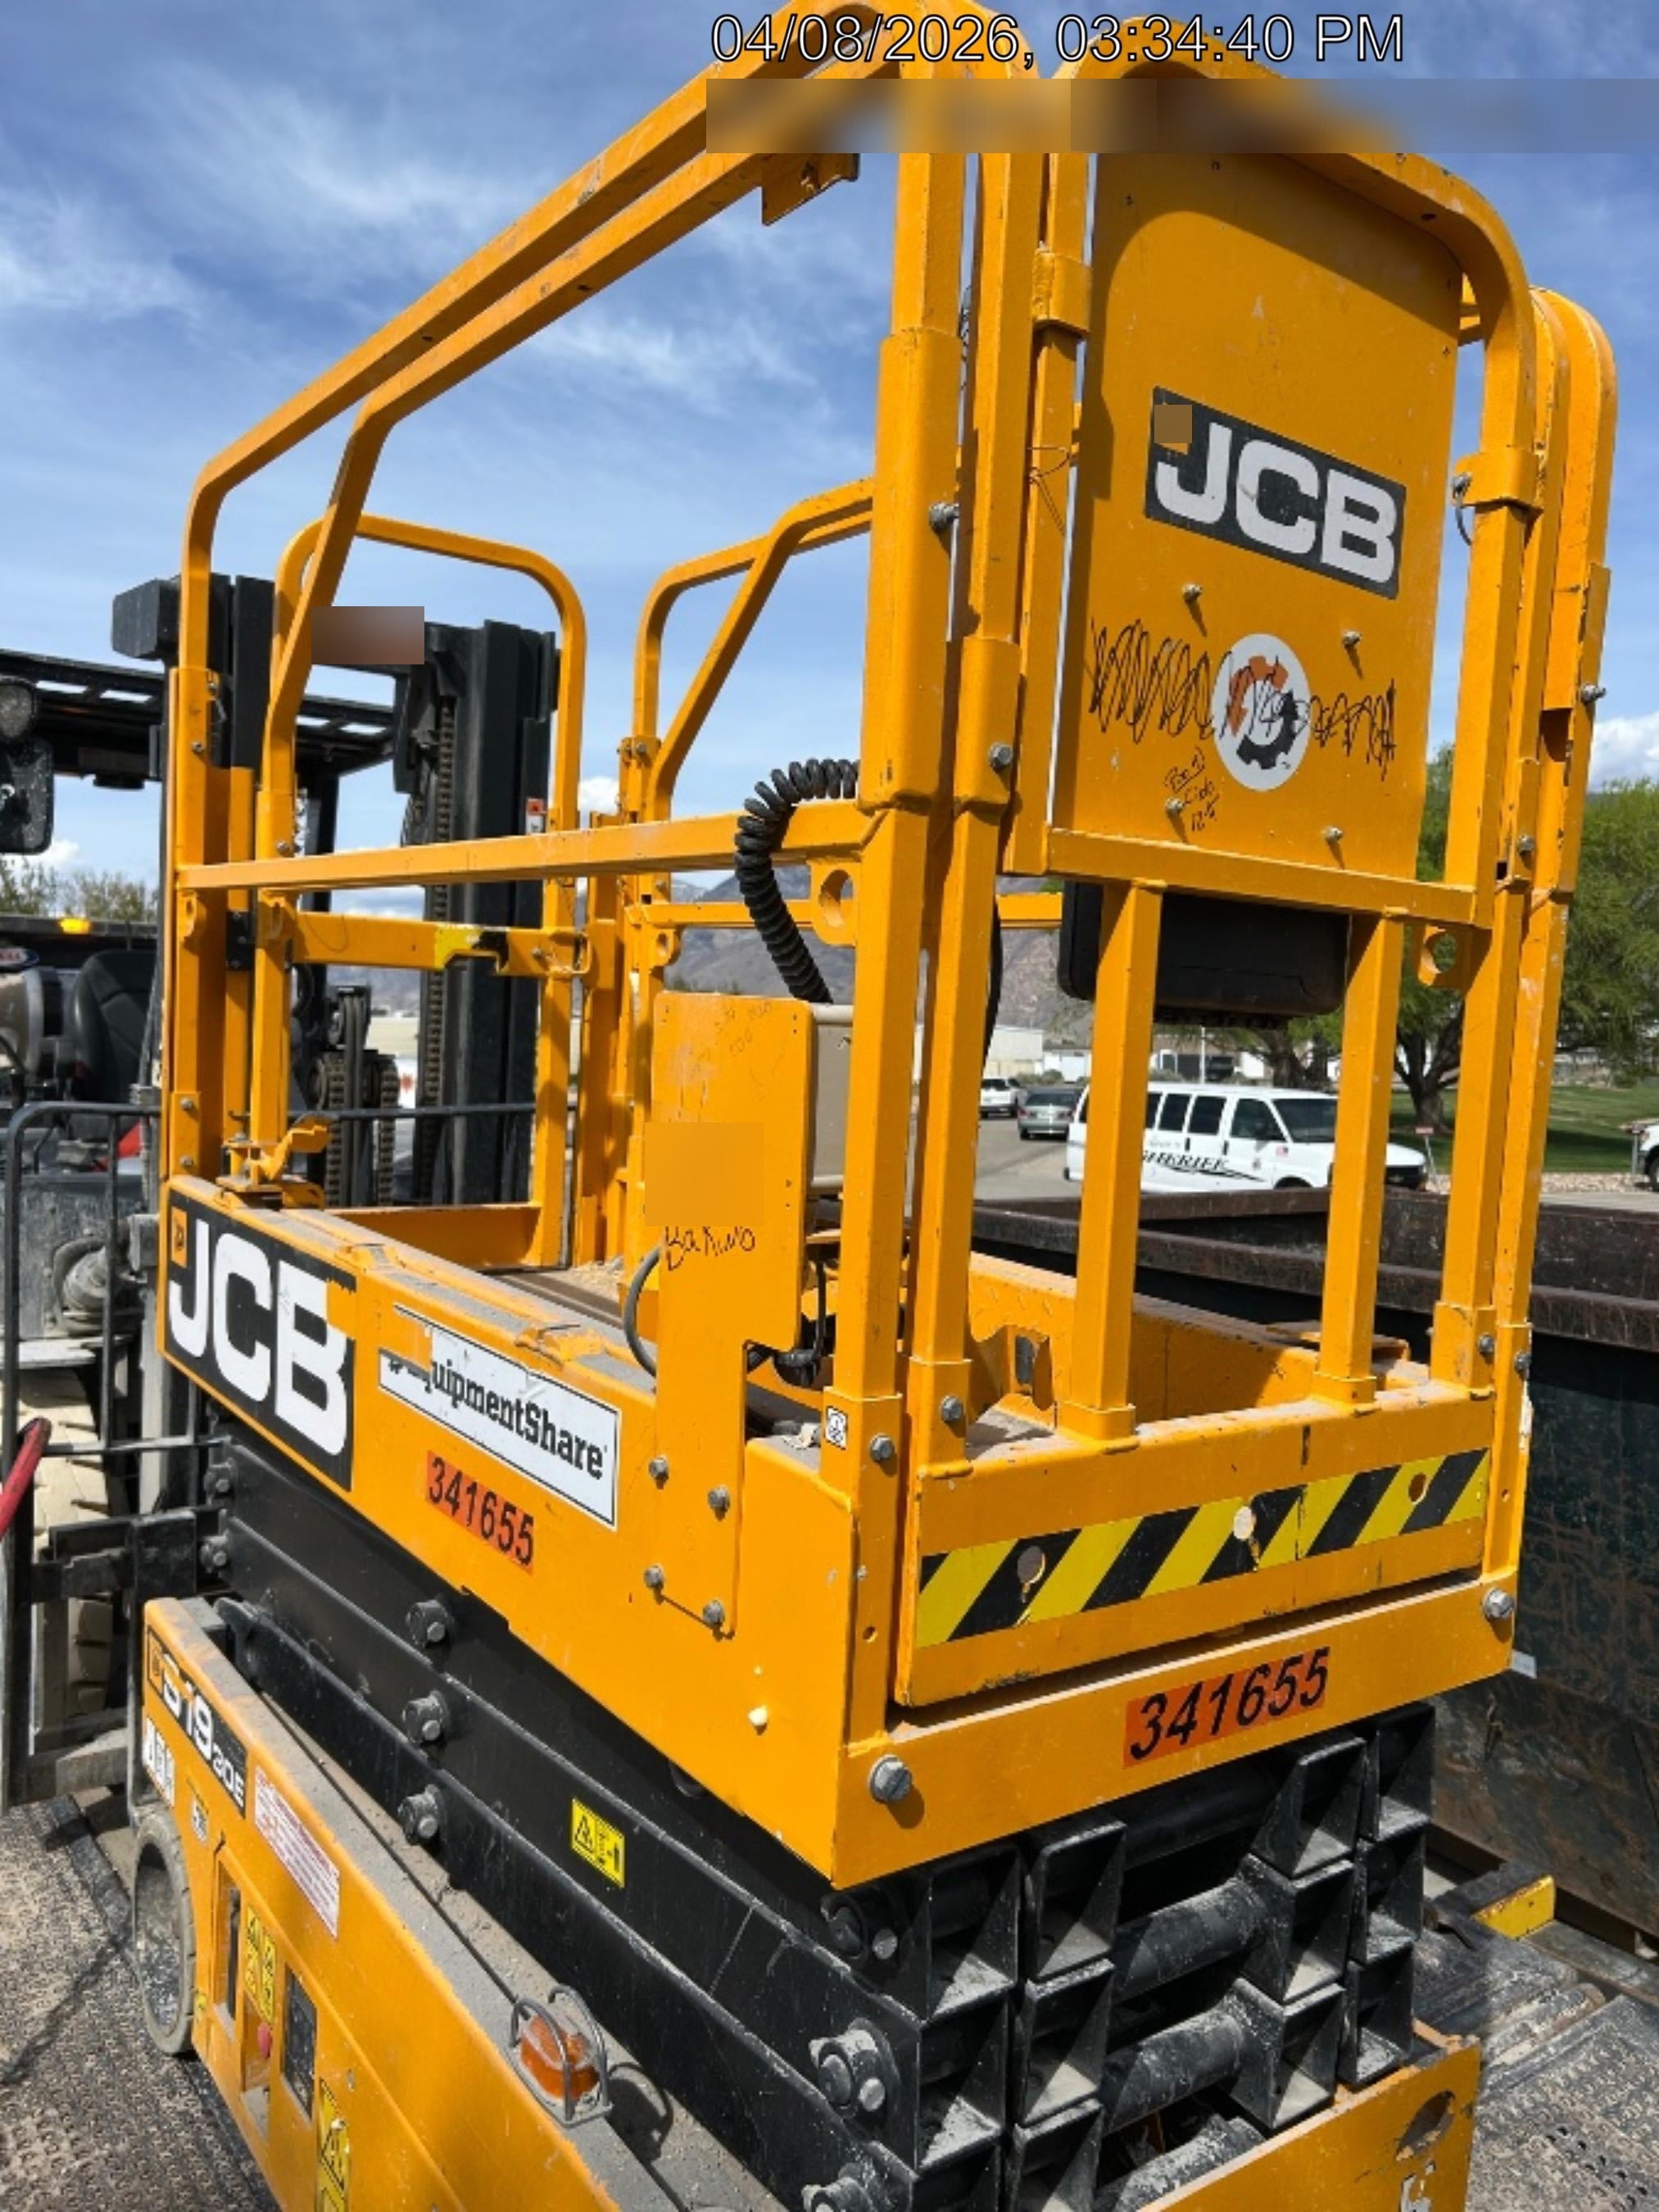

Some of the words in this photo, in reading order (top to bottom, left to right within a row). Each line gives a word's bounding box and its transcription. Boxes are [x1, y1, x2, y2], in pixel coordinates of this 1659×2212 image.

[1154, 421, 1398, 585] JCB
[168, 1218, 347, 1457] JCB
[408, 1358, 603, 1480] uipmentShare
[428, 1456, 534, 1566] 341655
[1130, 1647, 1330, 1761] 341655
